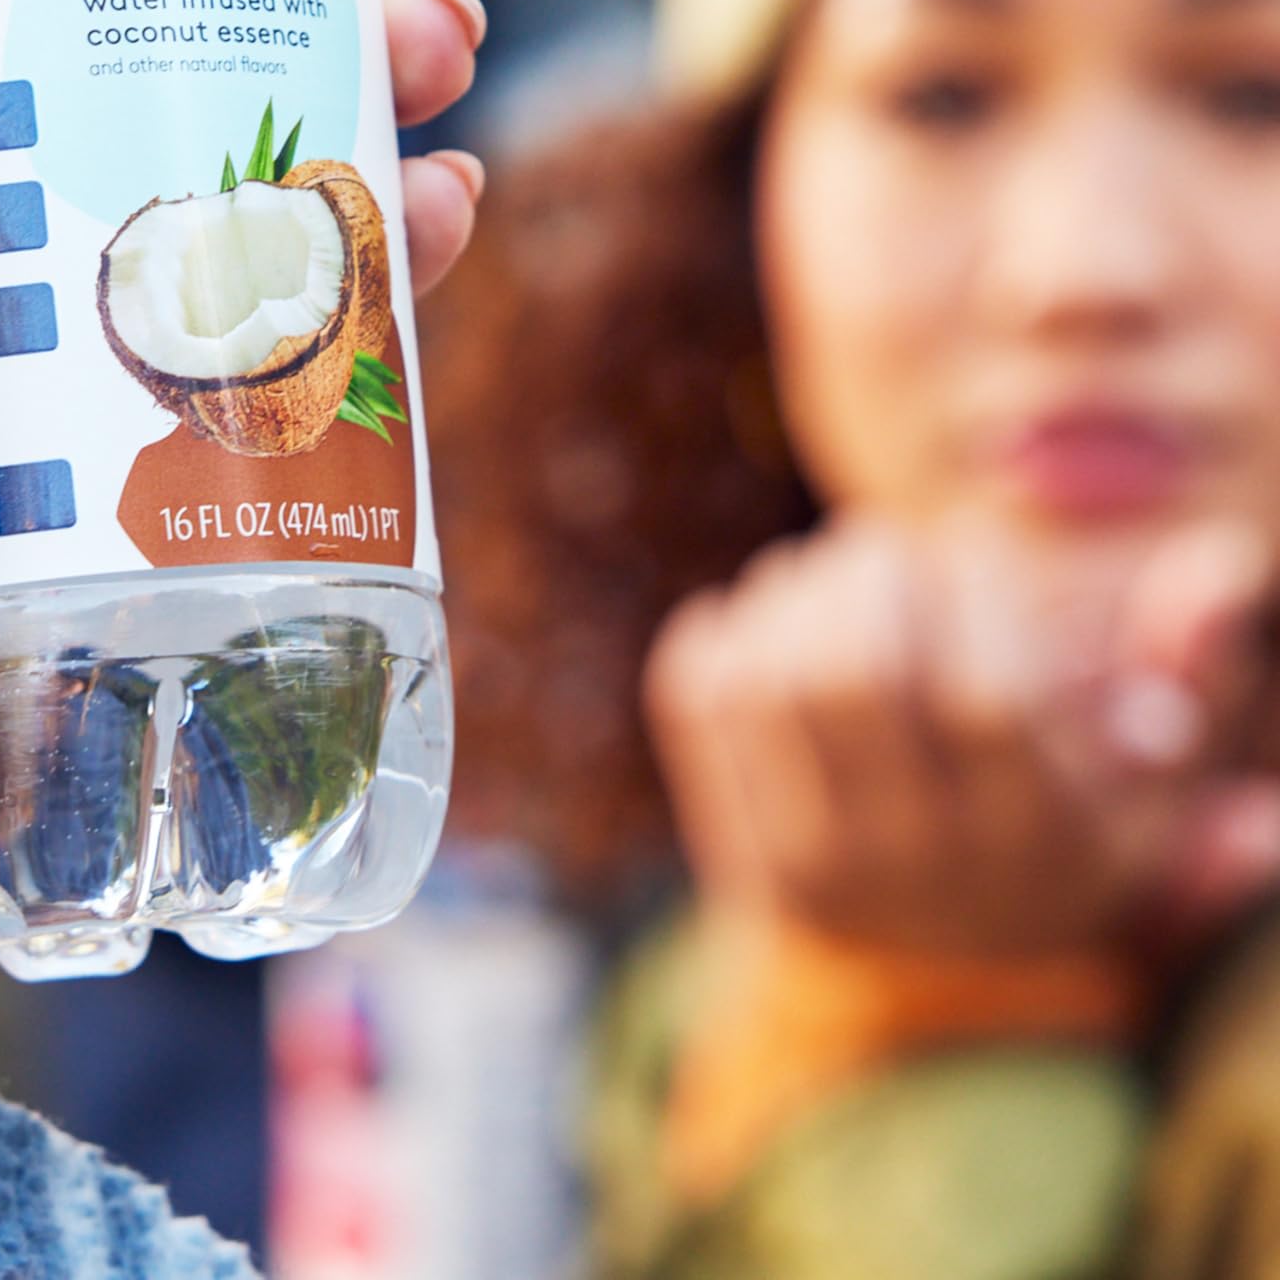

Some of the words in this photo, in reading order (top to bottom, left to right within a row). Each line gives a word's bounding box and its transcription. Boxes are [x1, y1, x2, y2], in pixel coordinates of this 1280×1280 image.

[86, 21, 208, 46] coconut
[218, 24, 310, 48] essence
[89, 57, 123, 76] and
[129, 56, 174, 74] other
[180, 56, 237, 73] natural
[241, 56, 288, 75] flavors
[159, 506, 194, 541] 16
[198, 504, 231, 538] FL
[235, 502, 274, 537] OZ
[278, 501, 328, 539] (474
[331, 504, 369, 542] mL)
